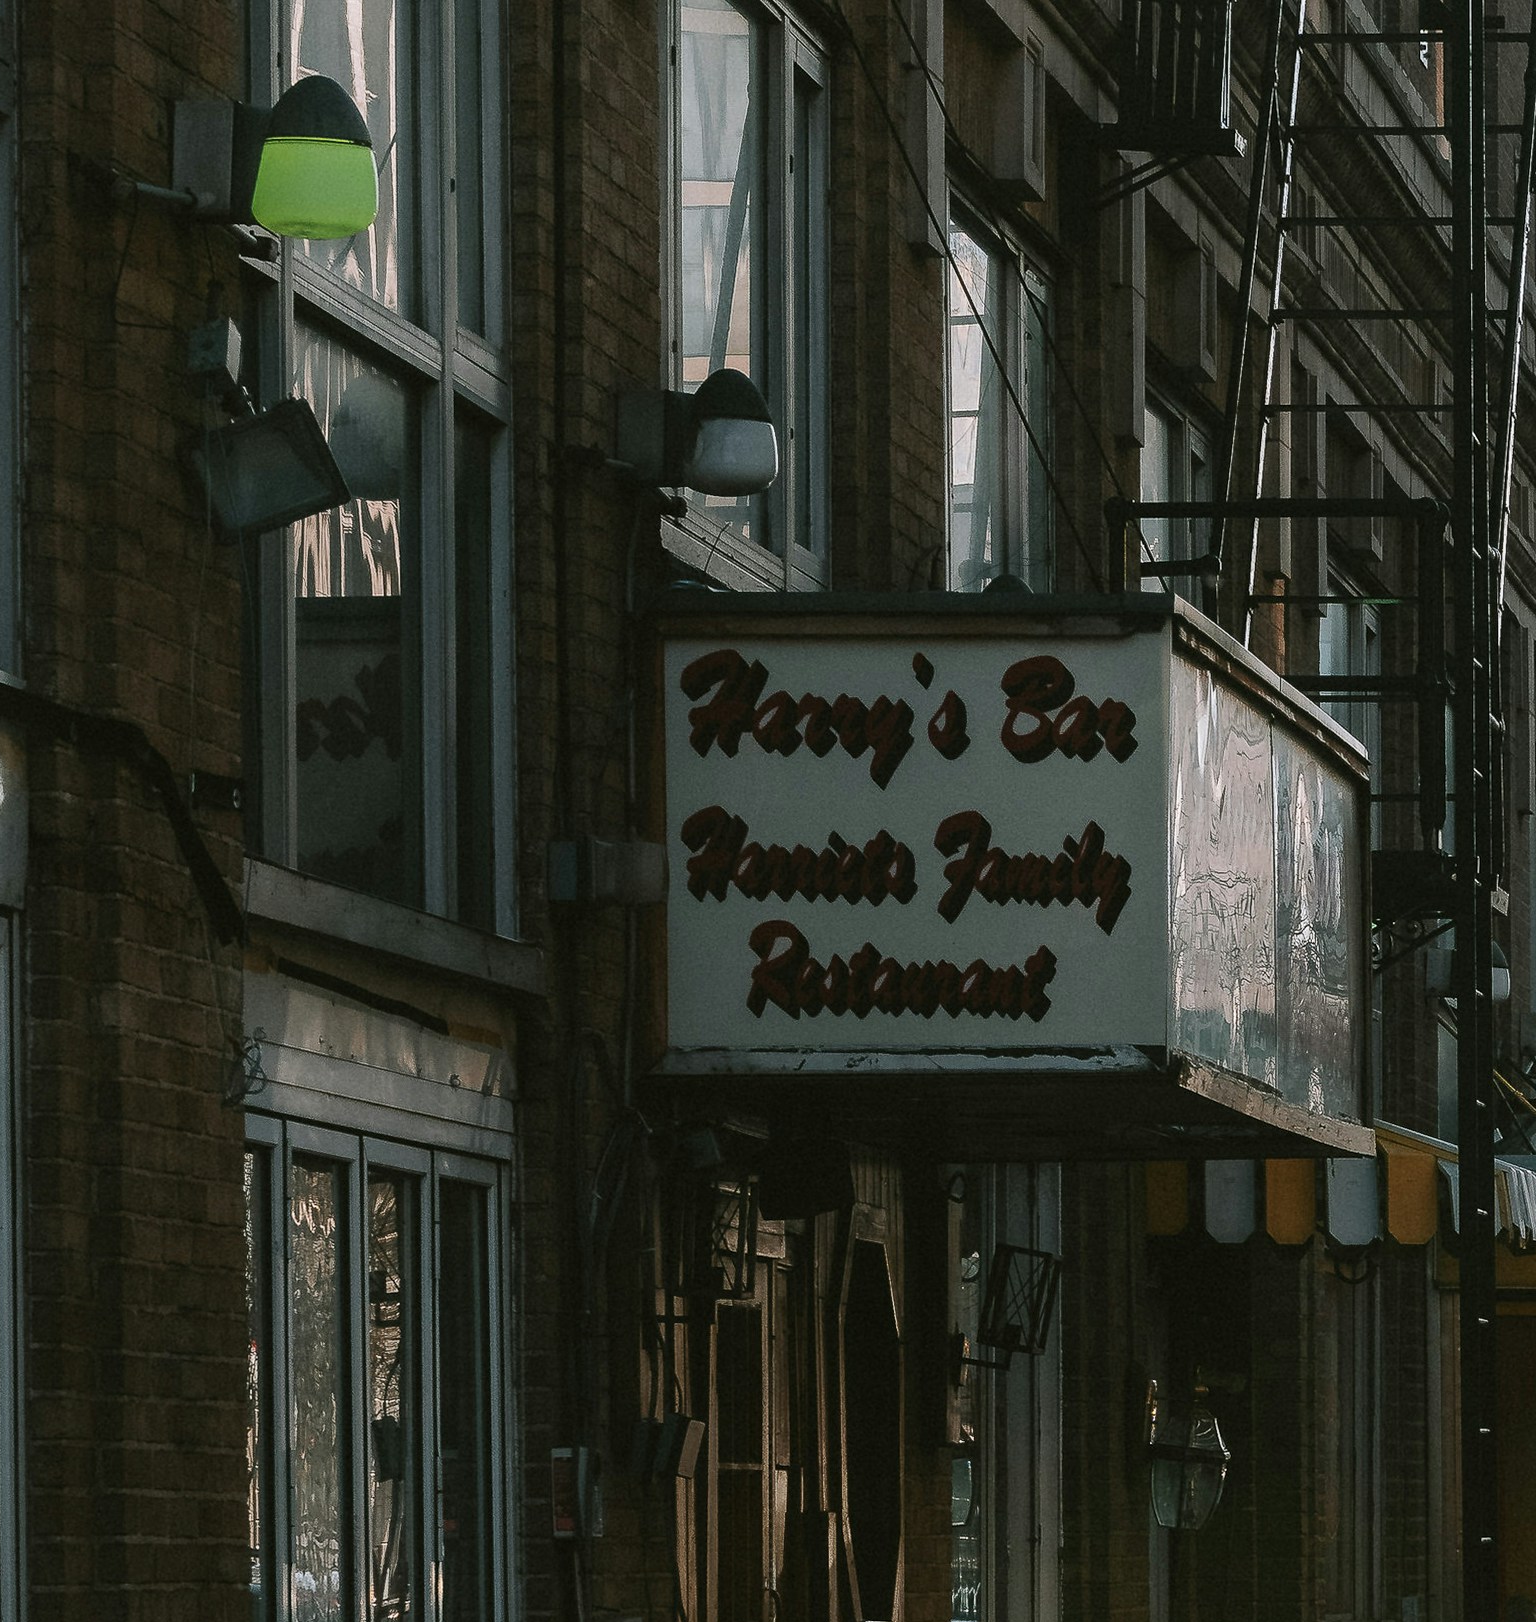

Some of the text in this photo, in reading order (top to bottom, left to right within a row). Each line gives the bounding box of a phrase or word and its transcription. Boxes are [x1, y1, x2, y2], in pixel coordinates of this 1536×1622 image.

[680, 650, 1137, 789] Harry's Bar
[680, 806, 1132, 937] Harriets Family
[746, 919, 1057, 1022] Restaurant
